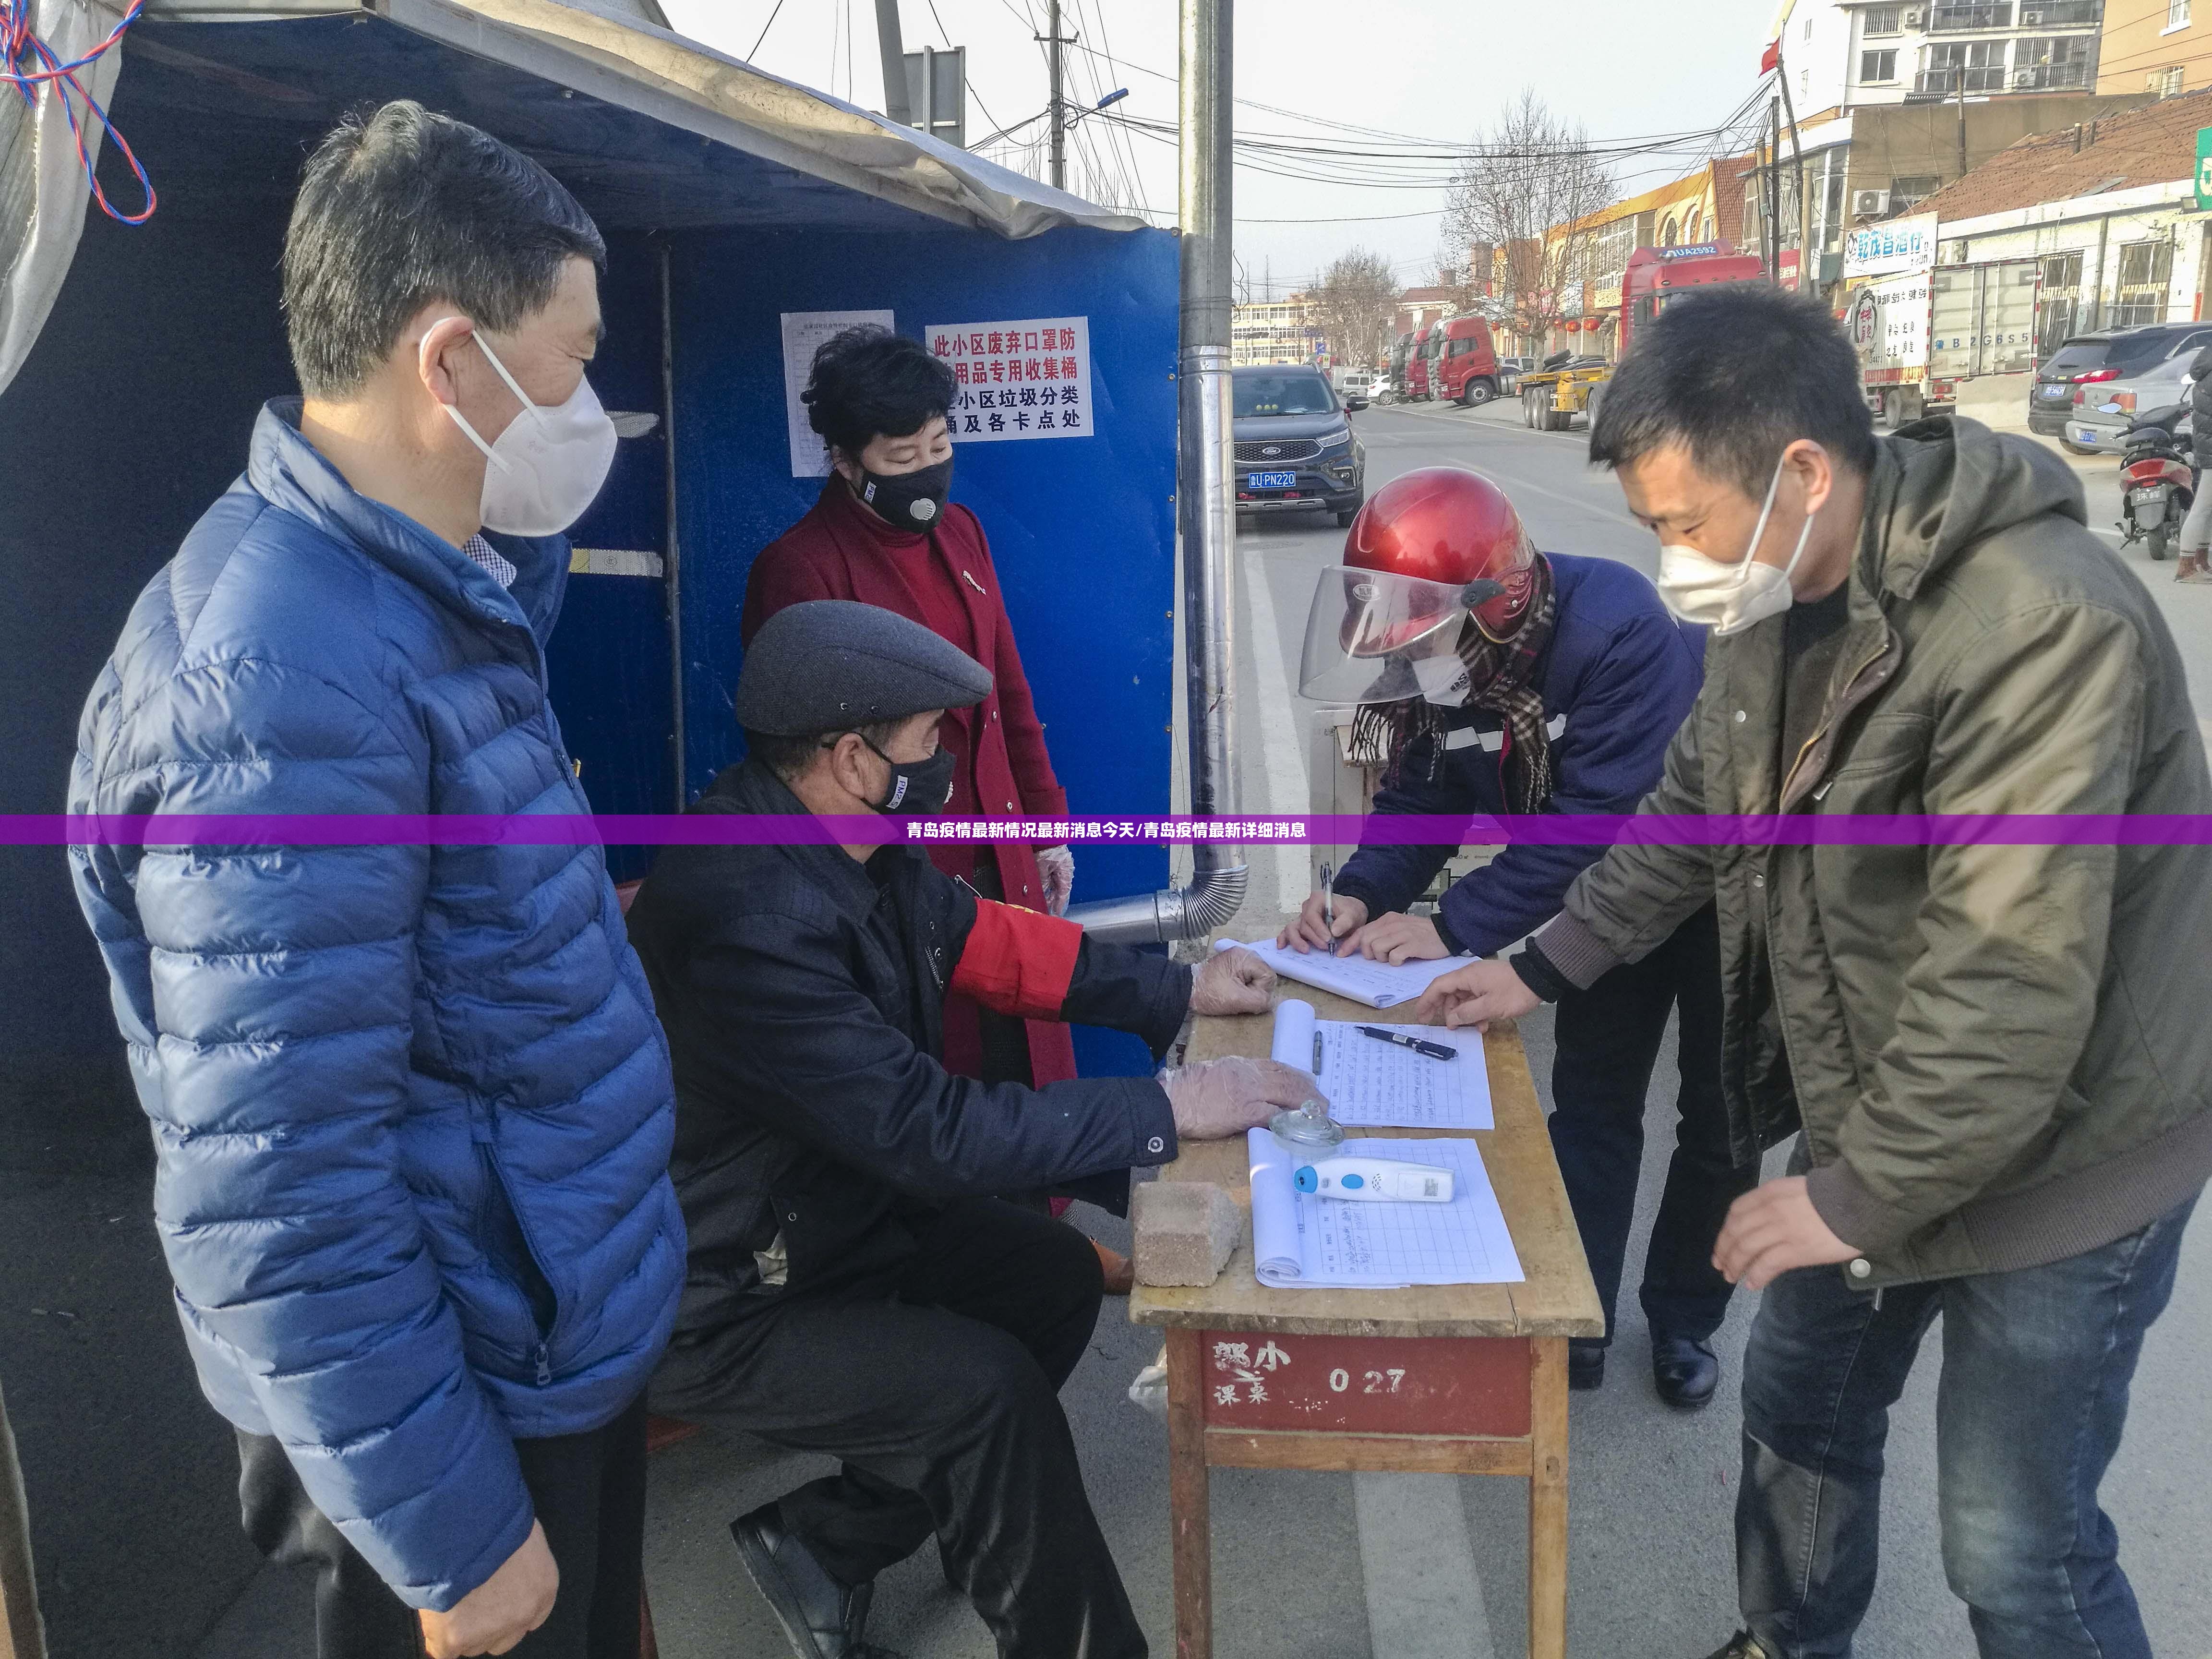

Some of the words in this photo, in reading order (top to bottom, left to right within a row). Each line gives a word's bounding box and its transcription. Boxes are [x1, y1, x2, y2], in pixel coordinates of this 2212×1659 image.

[934, 327, 1076, 358] 此小区废弃口罩防
[946, 356, 1078, 385] 用品专用收集桶
[949, 385, 1079, 410] 小区垃圾分类
